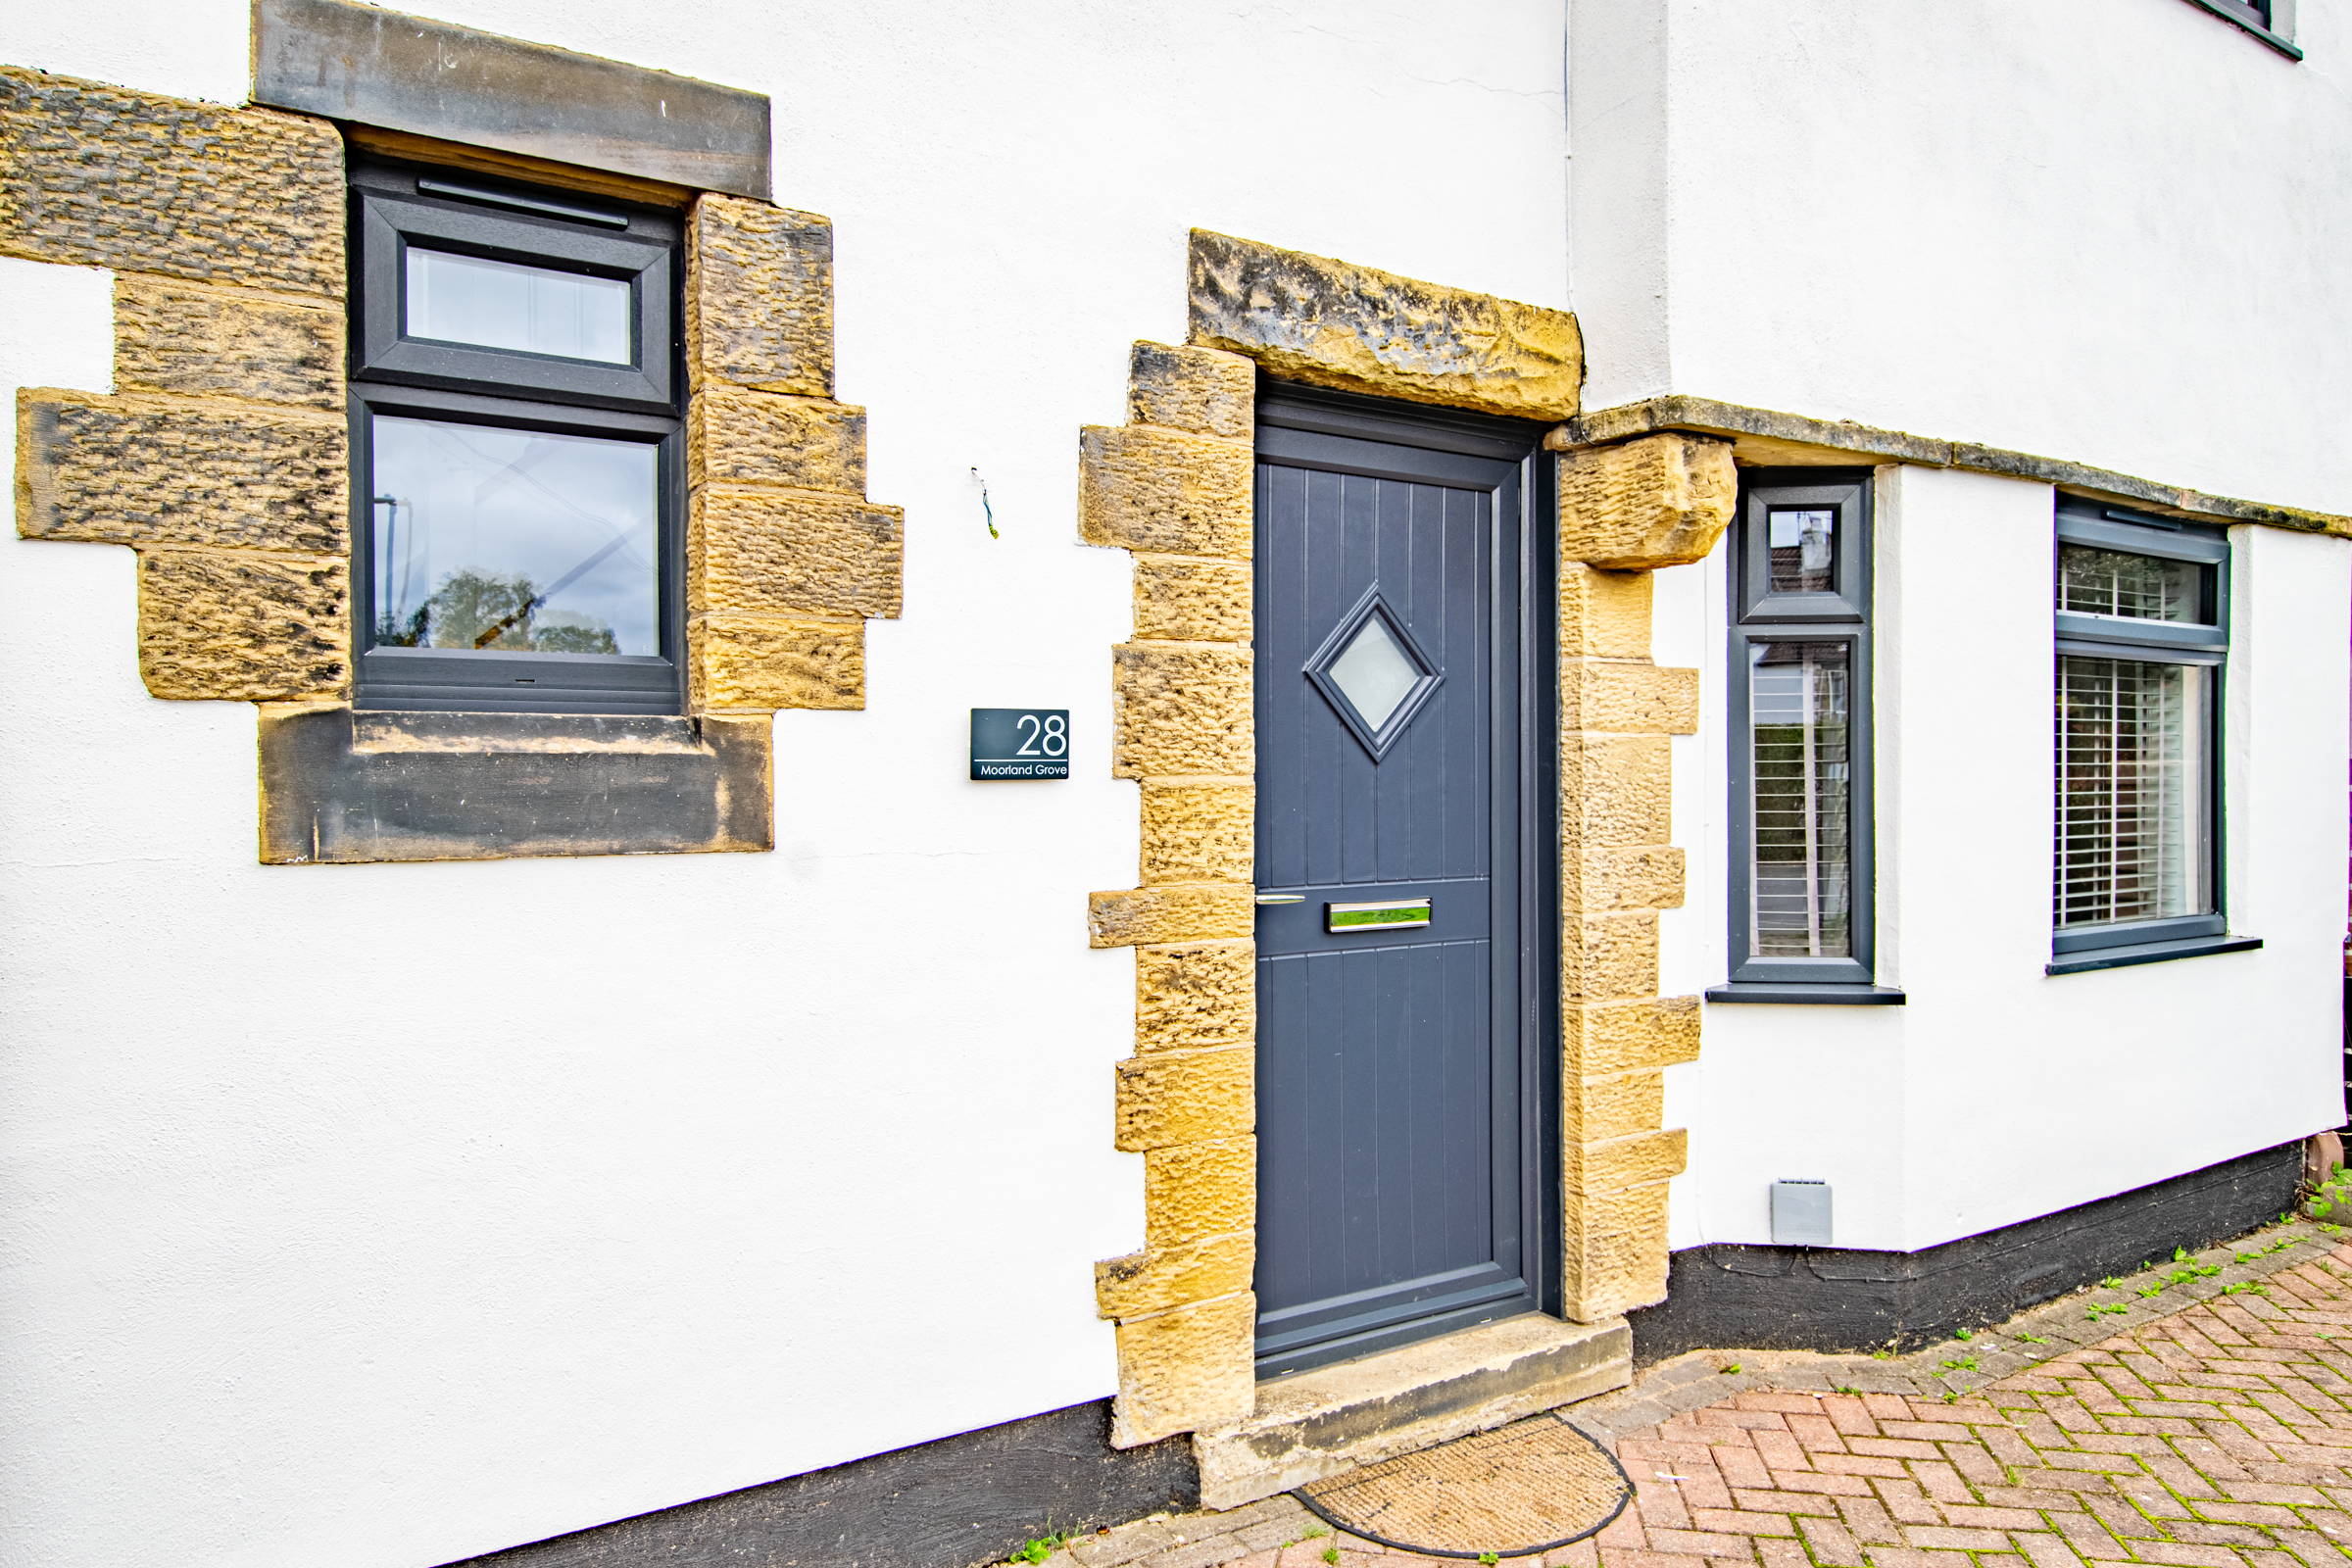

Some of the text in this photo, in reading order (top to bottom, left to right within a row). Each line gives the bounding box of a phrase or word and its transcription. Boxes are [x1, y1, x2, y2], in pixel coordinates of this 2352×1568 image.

[1016, 714, 1067, 757] 28
[980, 764, 1068, 775] Moorland Grove
